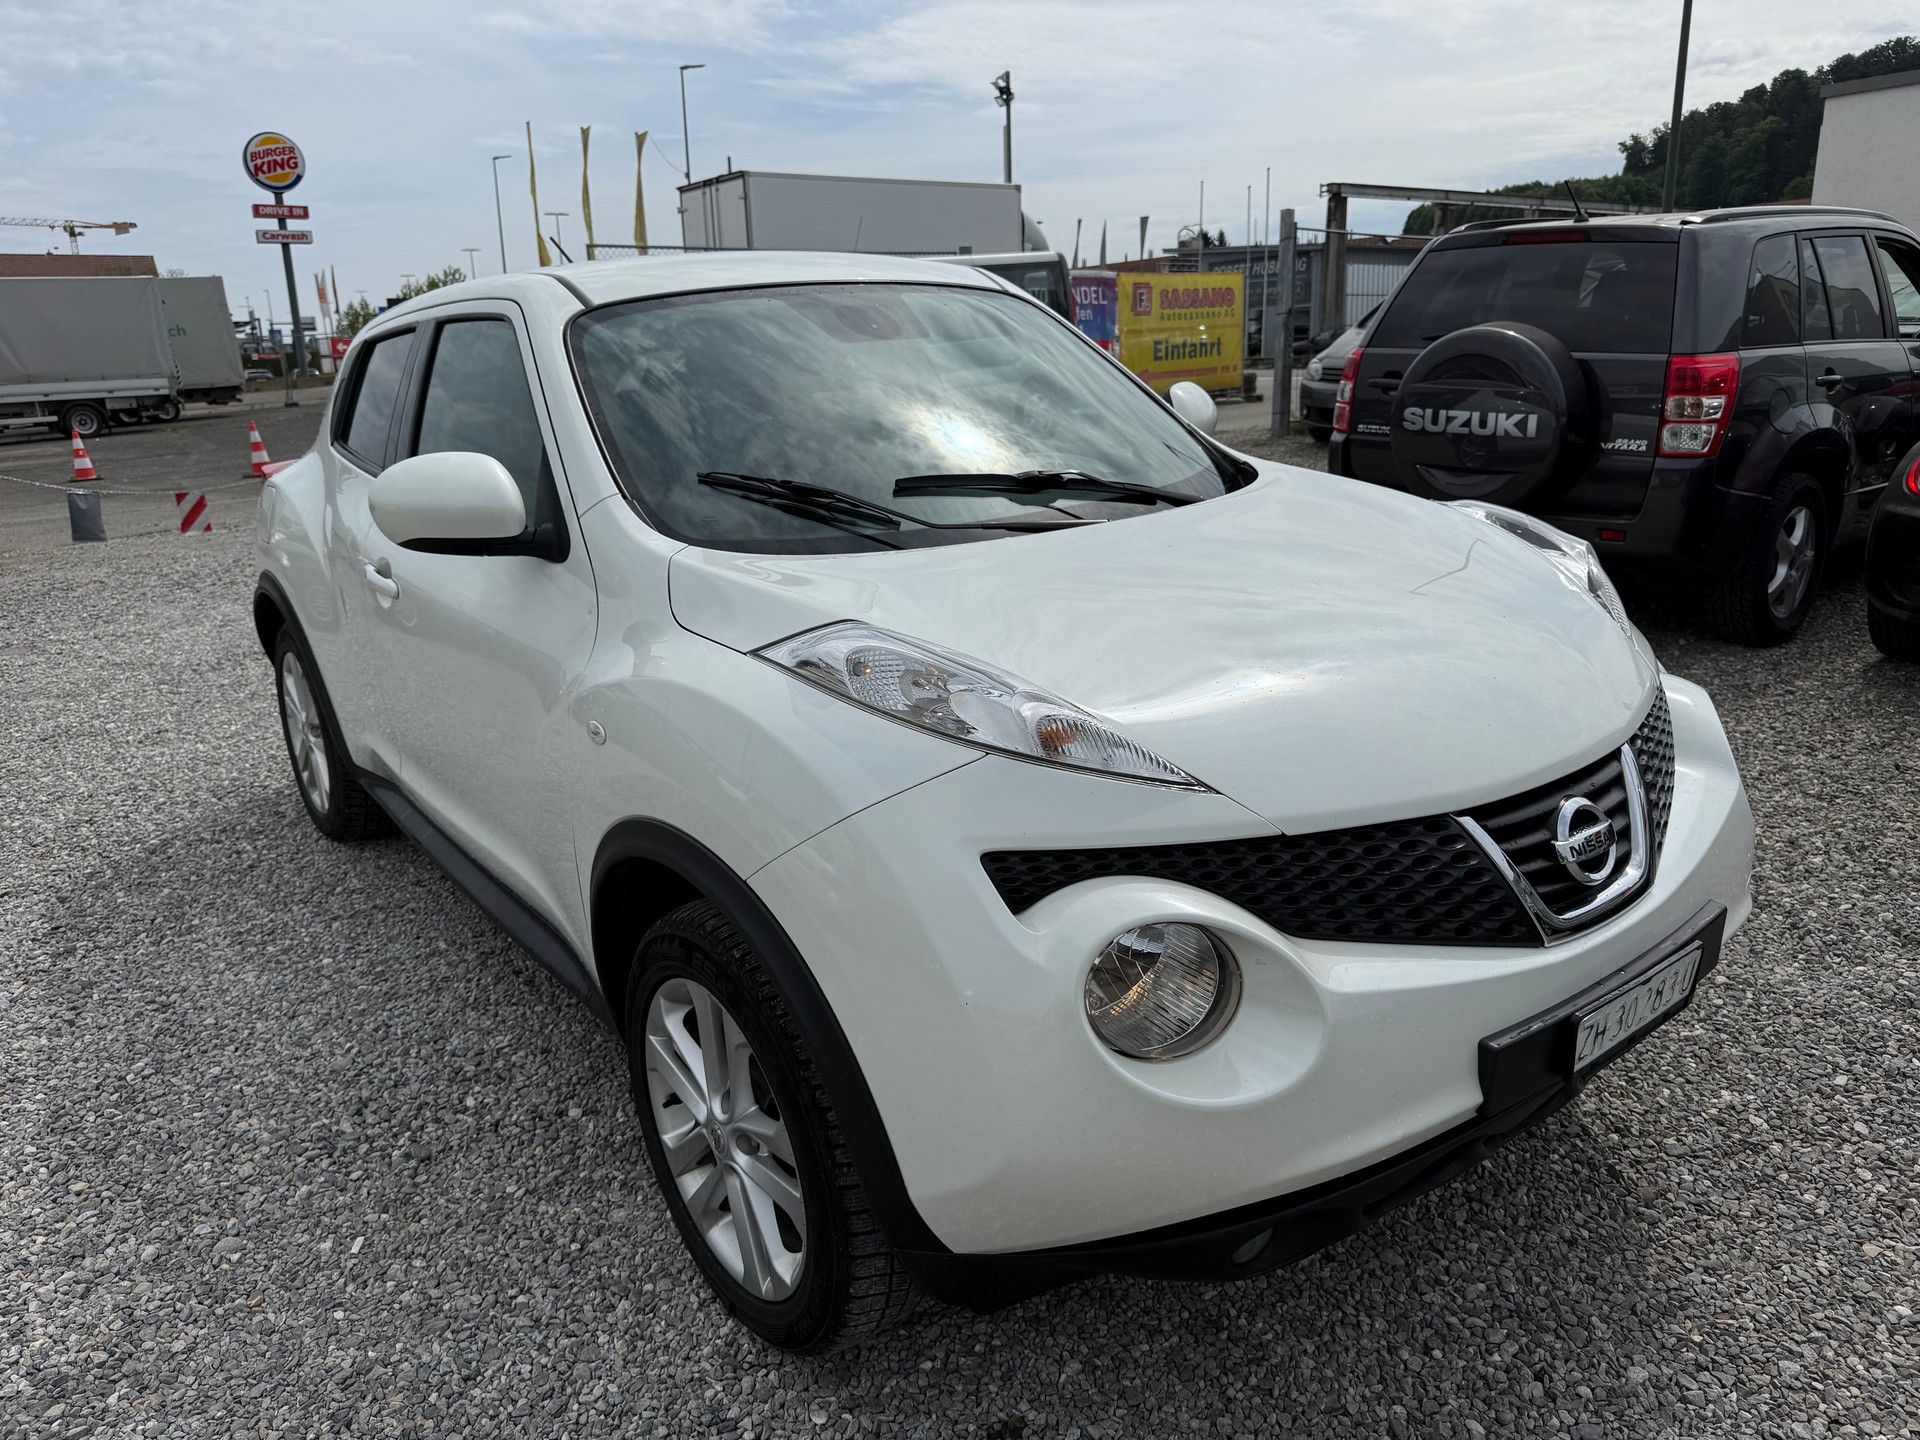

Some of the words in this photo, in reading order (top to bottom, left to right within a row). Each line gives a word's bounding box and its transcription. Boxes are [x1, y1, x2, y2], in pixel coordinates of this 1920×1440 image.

[250, 146, 296, 162] BURGER
[253, 156, 299, 177] KING
[259, 206, 290, 216] DRIVE
[293, 207, 304, 216] IN
[262, 232, 308, 241] Carwash
[1159, 287, 1235, 310] SASSANO
[1224, 308, 1236, 318] AG
[1153, 337, 1222, 361] Einfahrt
[1402, 406, 1538, 438] SUZUKI
[1357, 424, 1390, 434] SUZUK
[1600, 442, 1647, 452] VITARA
[1615, 438, 1648, 446] GRAND
